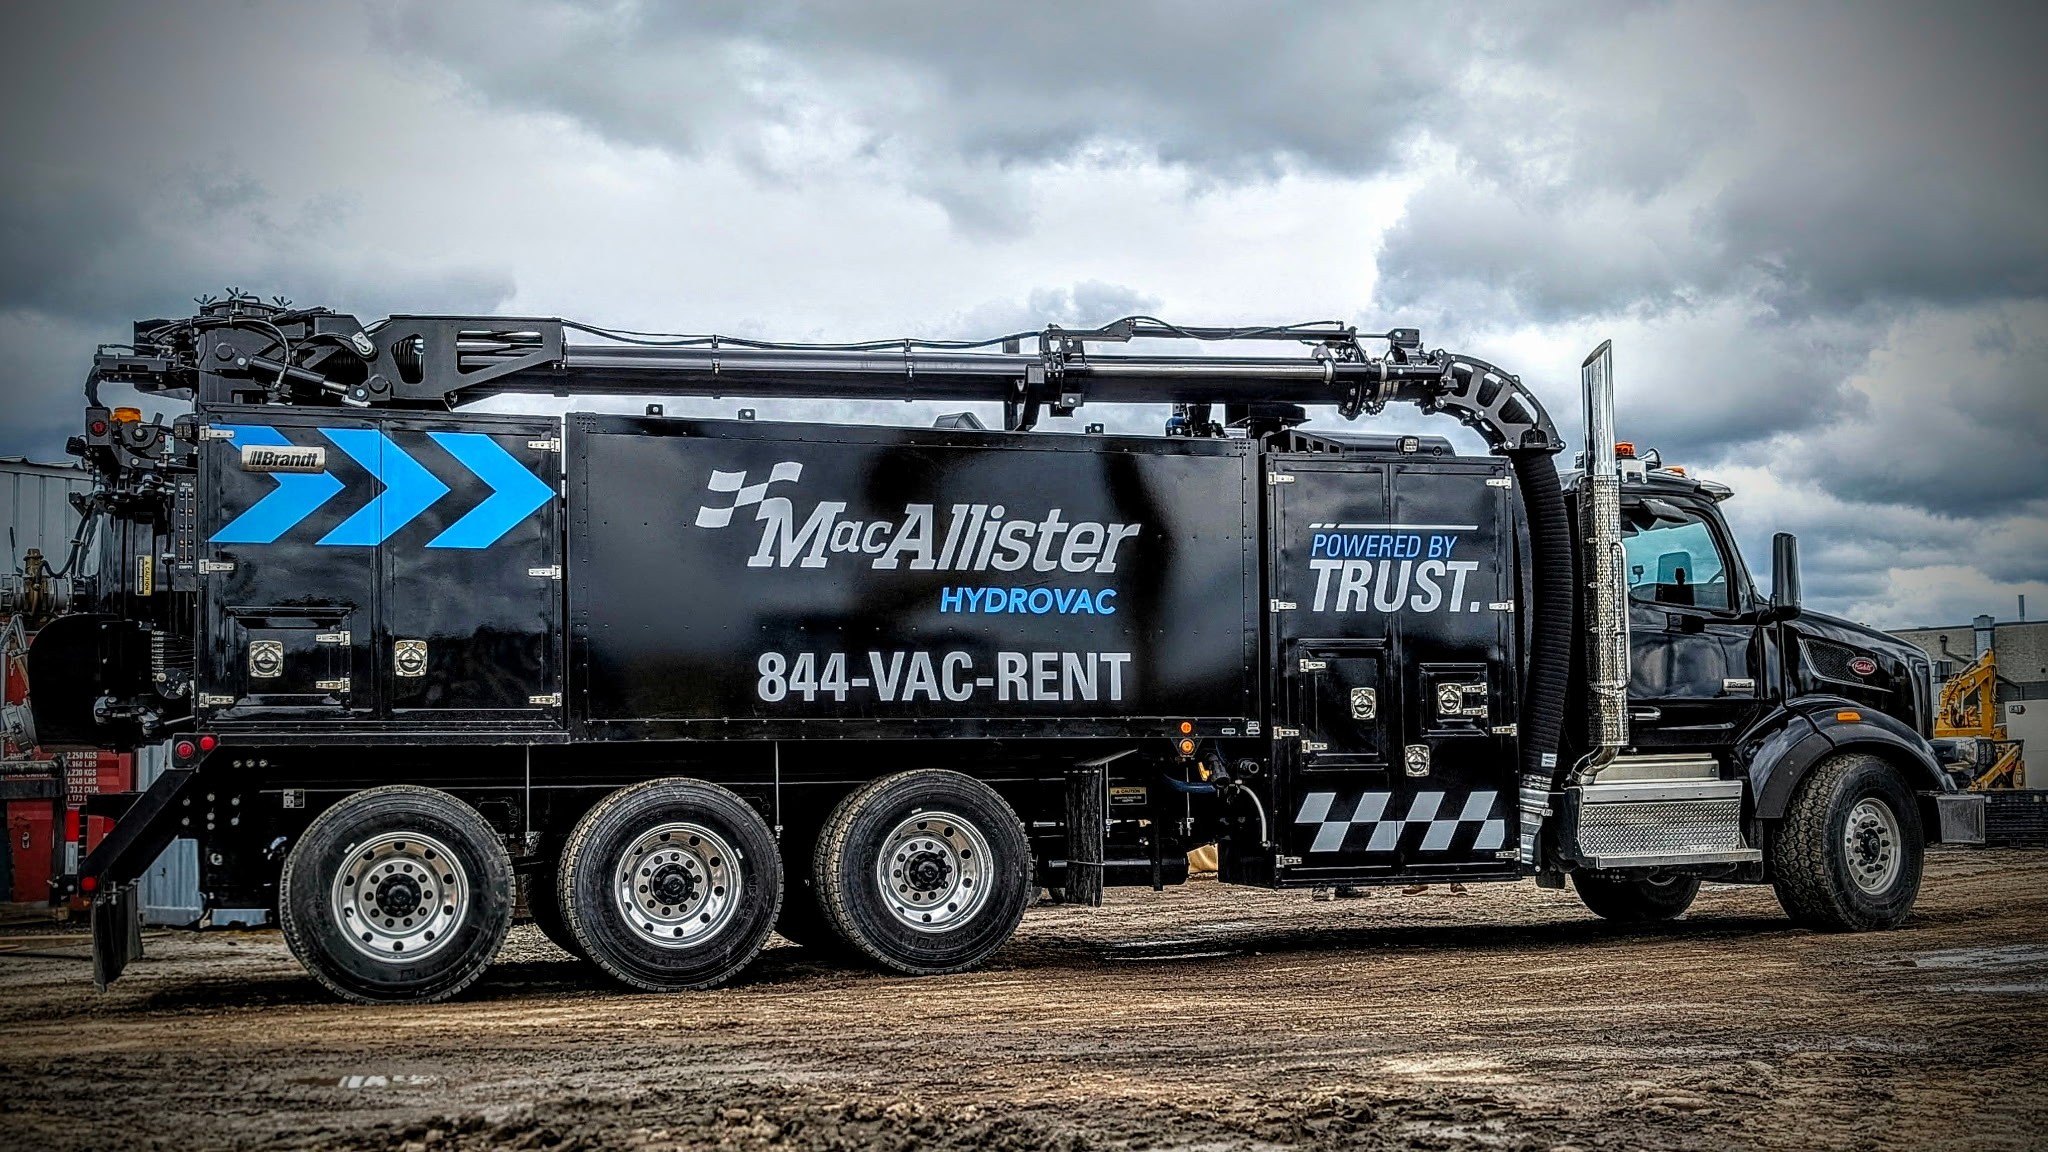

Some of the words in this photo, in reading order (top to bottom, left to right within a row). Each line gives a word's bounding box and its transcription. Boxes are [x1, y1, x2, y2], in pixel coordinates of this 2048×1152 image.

[261, 451, 318, 467] Brandt
[747, 497, 1141, 574] MacAllister
[1311, 533, 1421, 558] POWERED
[1428, 535, 1458, 558] BY
[1309, 559, 1480, 613] TRUST.
[939, 587, 1117, 615] HYDROVAC
[757, 650, 1131, 702] 844-VAC-RENT
[84, 752, 97, 760] KGS
[84, 760, 97, 768] LBS
